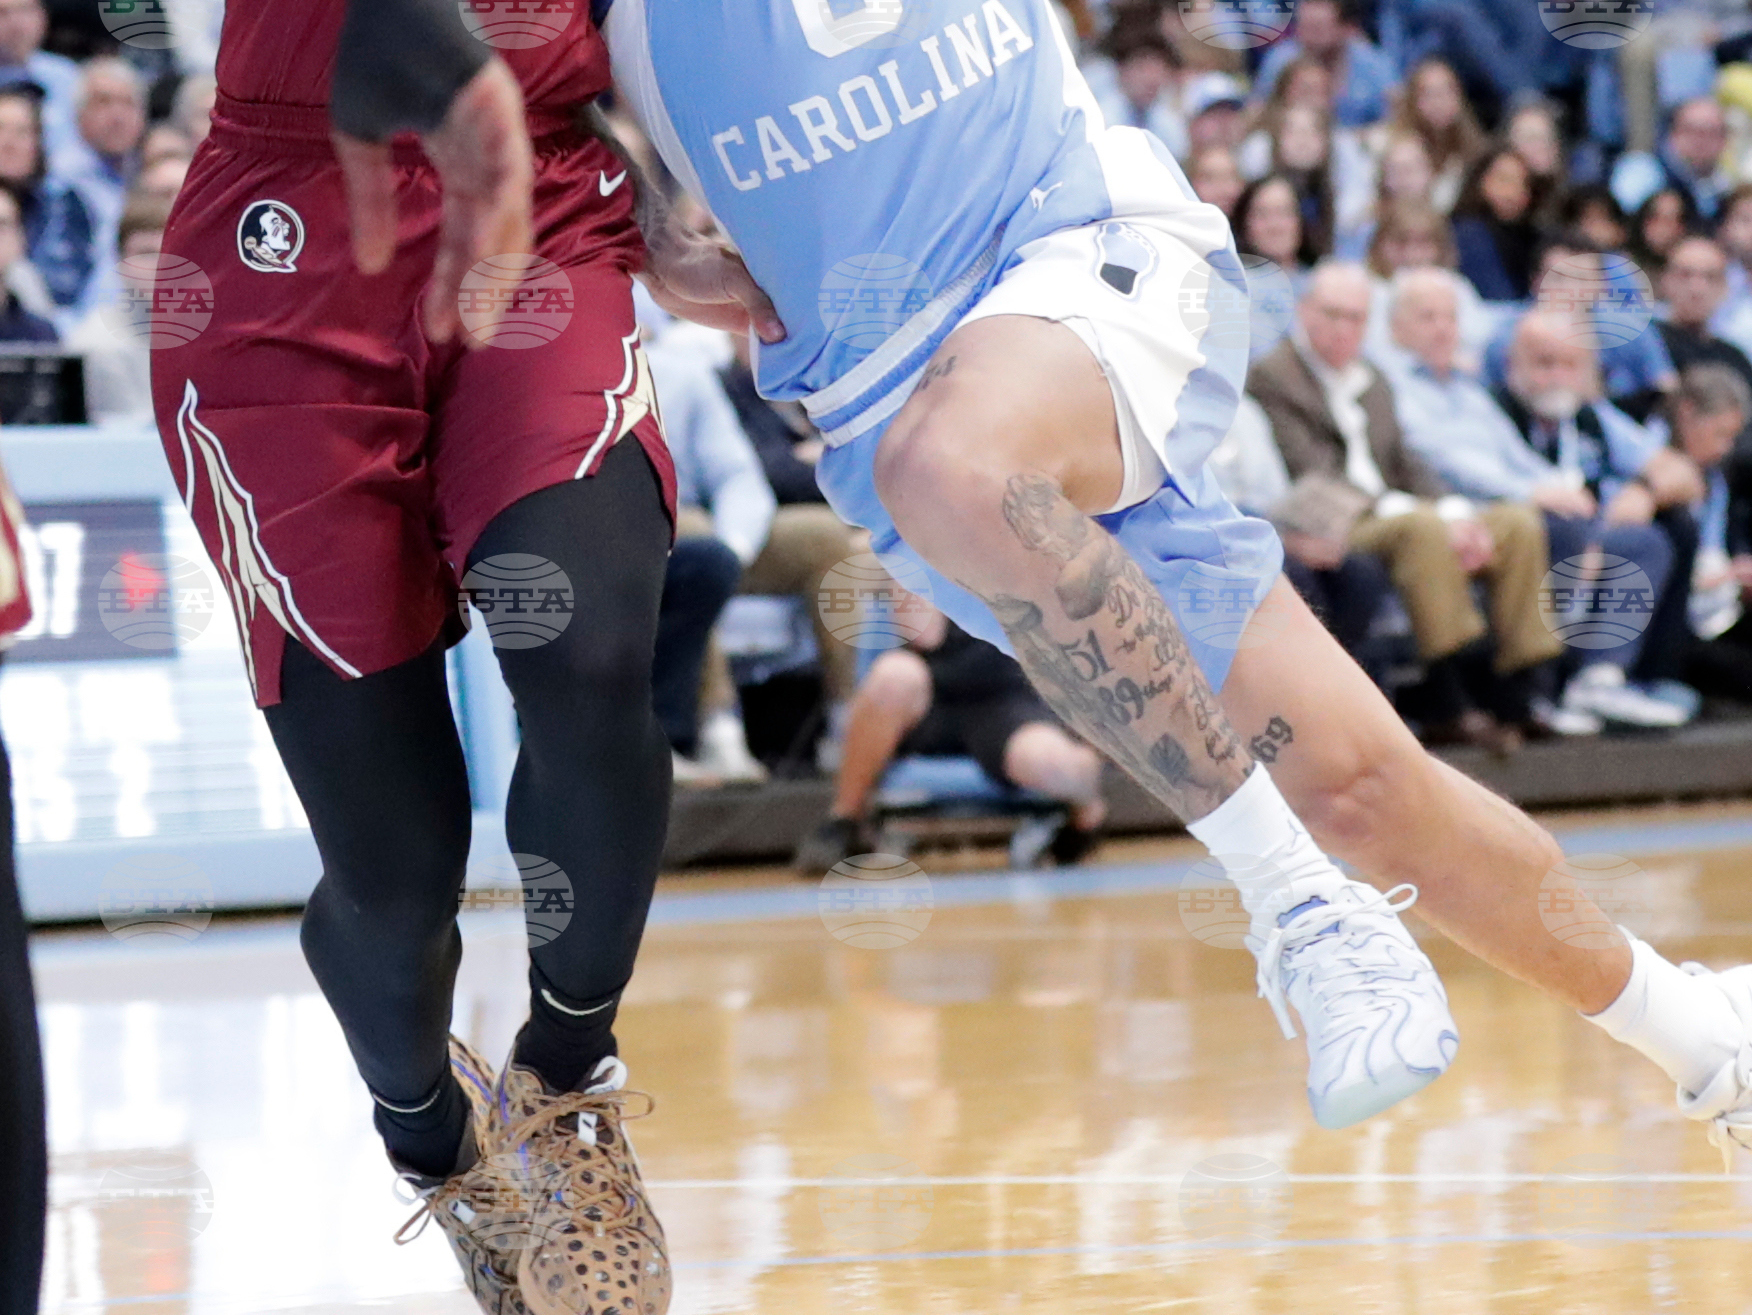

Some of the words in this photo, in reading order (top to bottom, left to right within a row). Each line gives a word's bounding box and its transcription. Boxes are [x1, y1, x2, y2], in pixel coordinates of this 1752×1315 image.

[1055, 629, 1114, 682] 51
[1098, 677, 1144, 726] 89
[1250, 715, 1293, 765] 69
